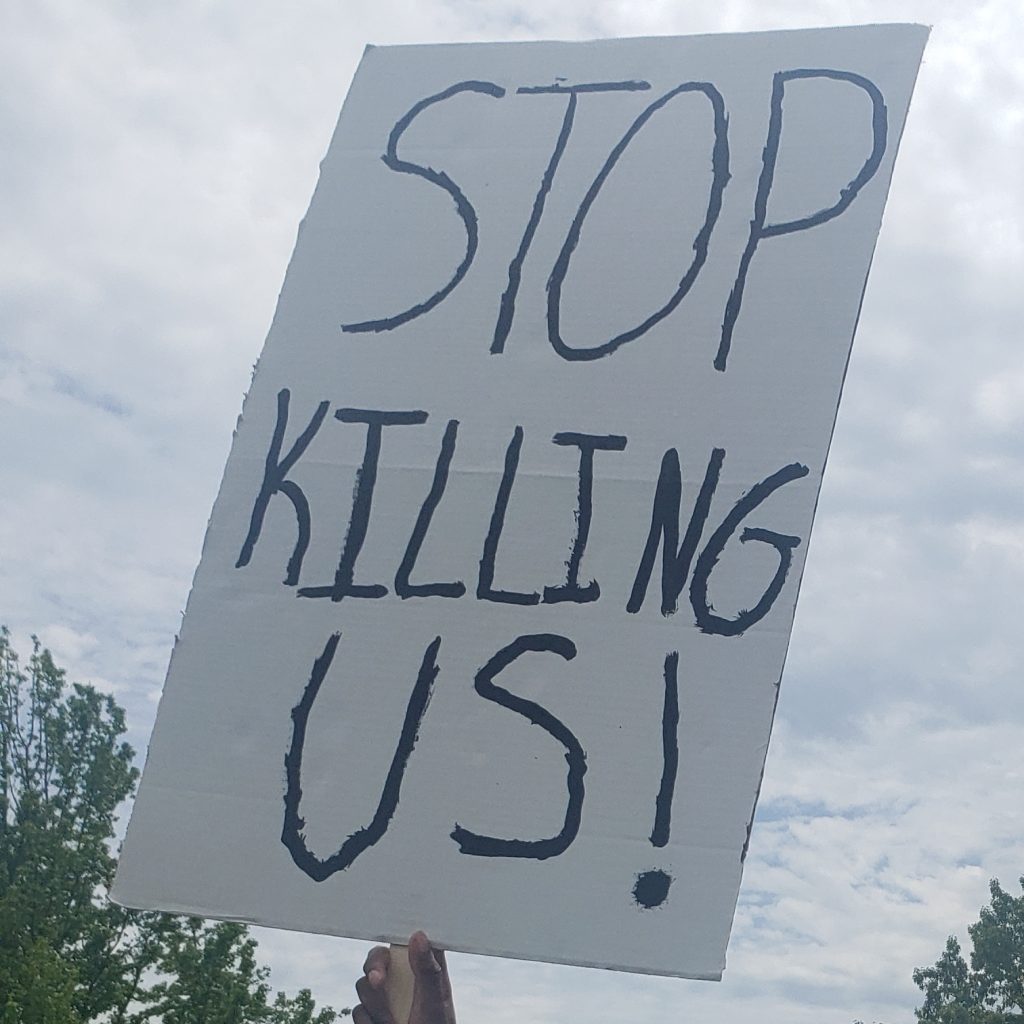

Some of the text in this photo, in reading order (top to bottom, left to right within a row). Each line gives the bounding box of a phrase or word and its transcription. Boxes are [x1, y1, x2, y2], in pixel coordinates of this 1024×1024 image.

[342, 69, 887, 371] STOP
[235, 389, 808, 635] KILLING
[281, 631, 681, 910] US!
